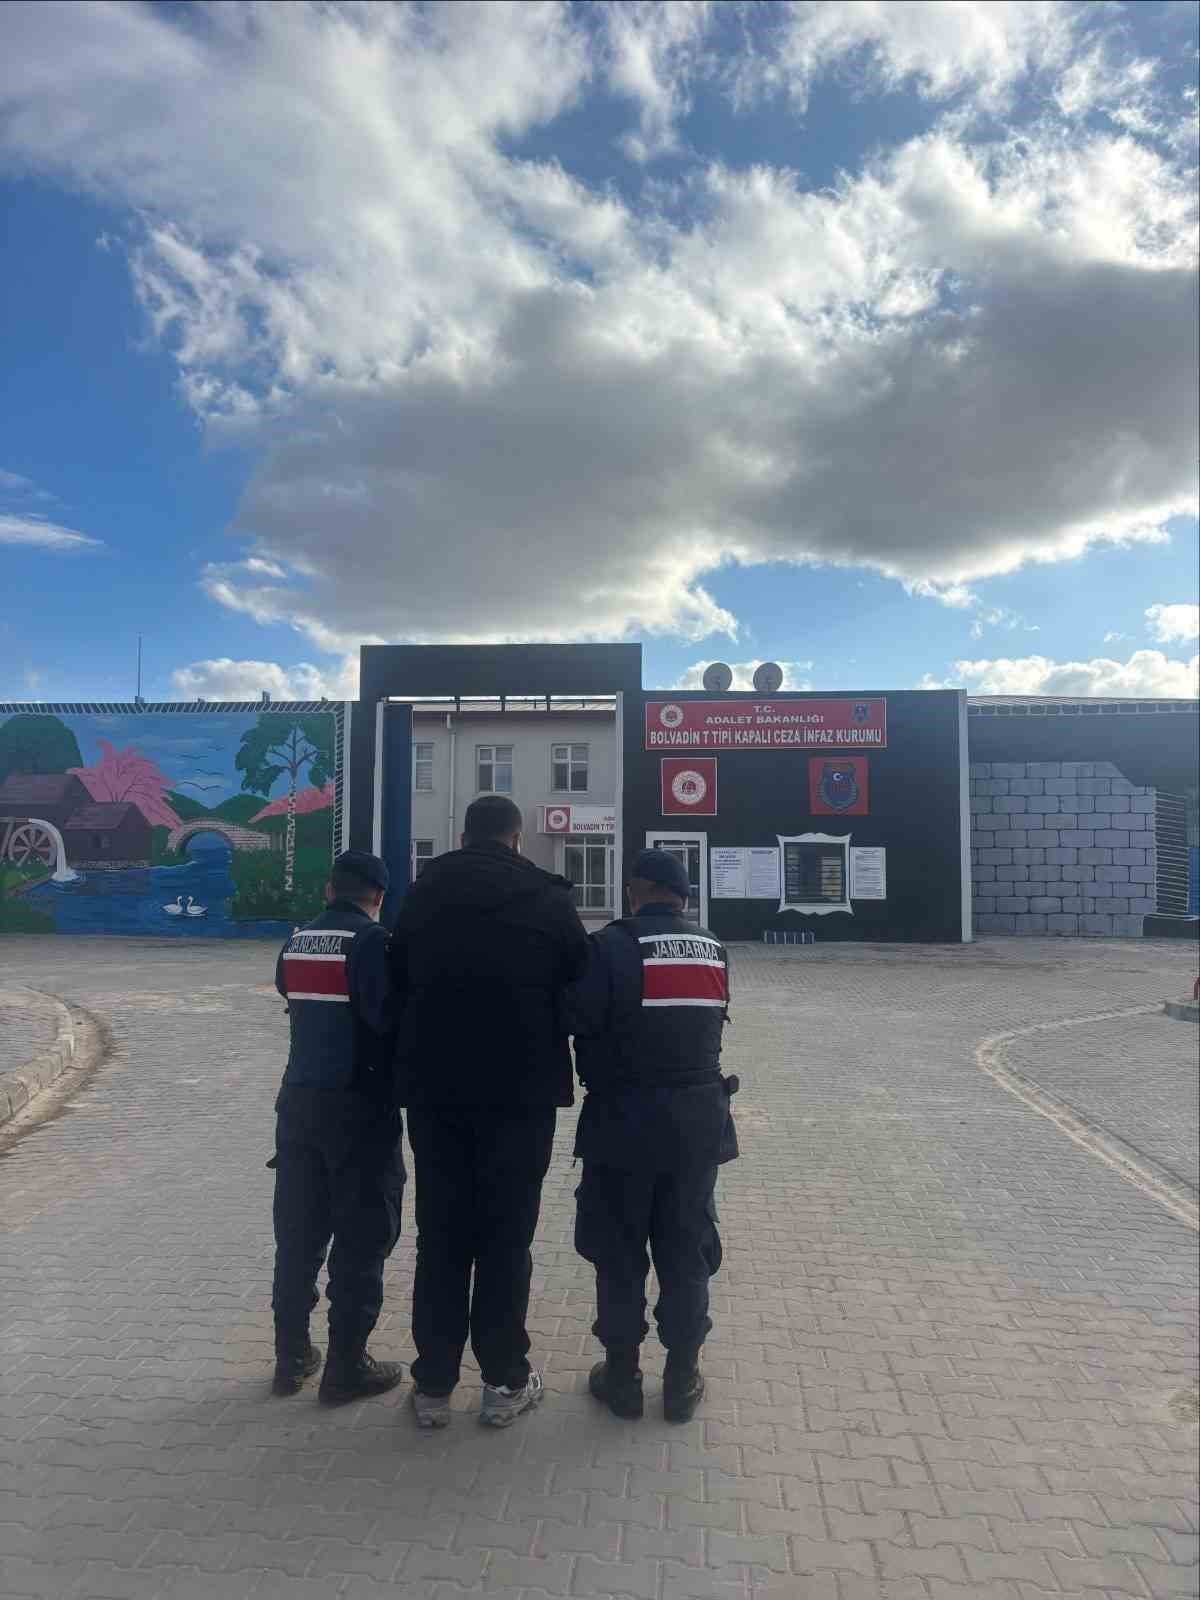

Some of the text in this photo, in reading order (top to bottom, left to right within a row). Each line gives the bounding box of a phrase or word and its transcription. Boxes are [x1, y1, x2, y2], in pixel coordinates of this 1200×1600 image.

[753, 705, 776, 713] T.C.
[705, 713, 825, 724] ADALET BAKANLIĞI
[650, 726, 882, 744] BOLVADİN T TİPİ KAPALI CEZA İNFAZ KURUMU
[288, 936, 343, 953] JANDARMA
[652, 940, 719, 960] JANDARMA
